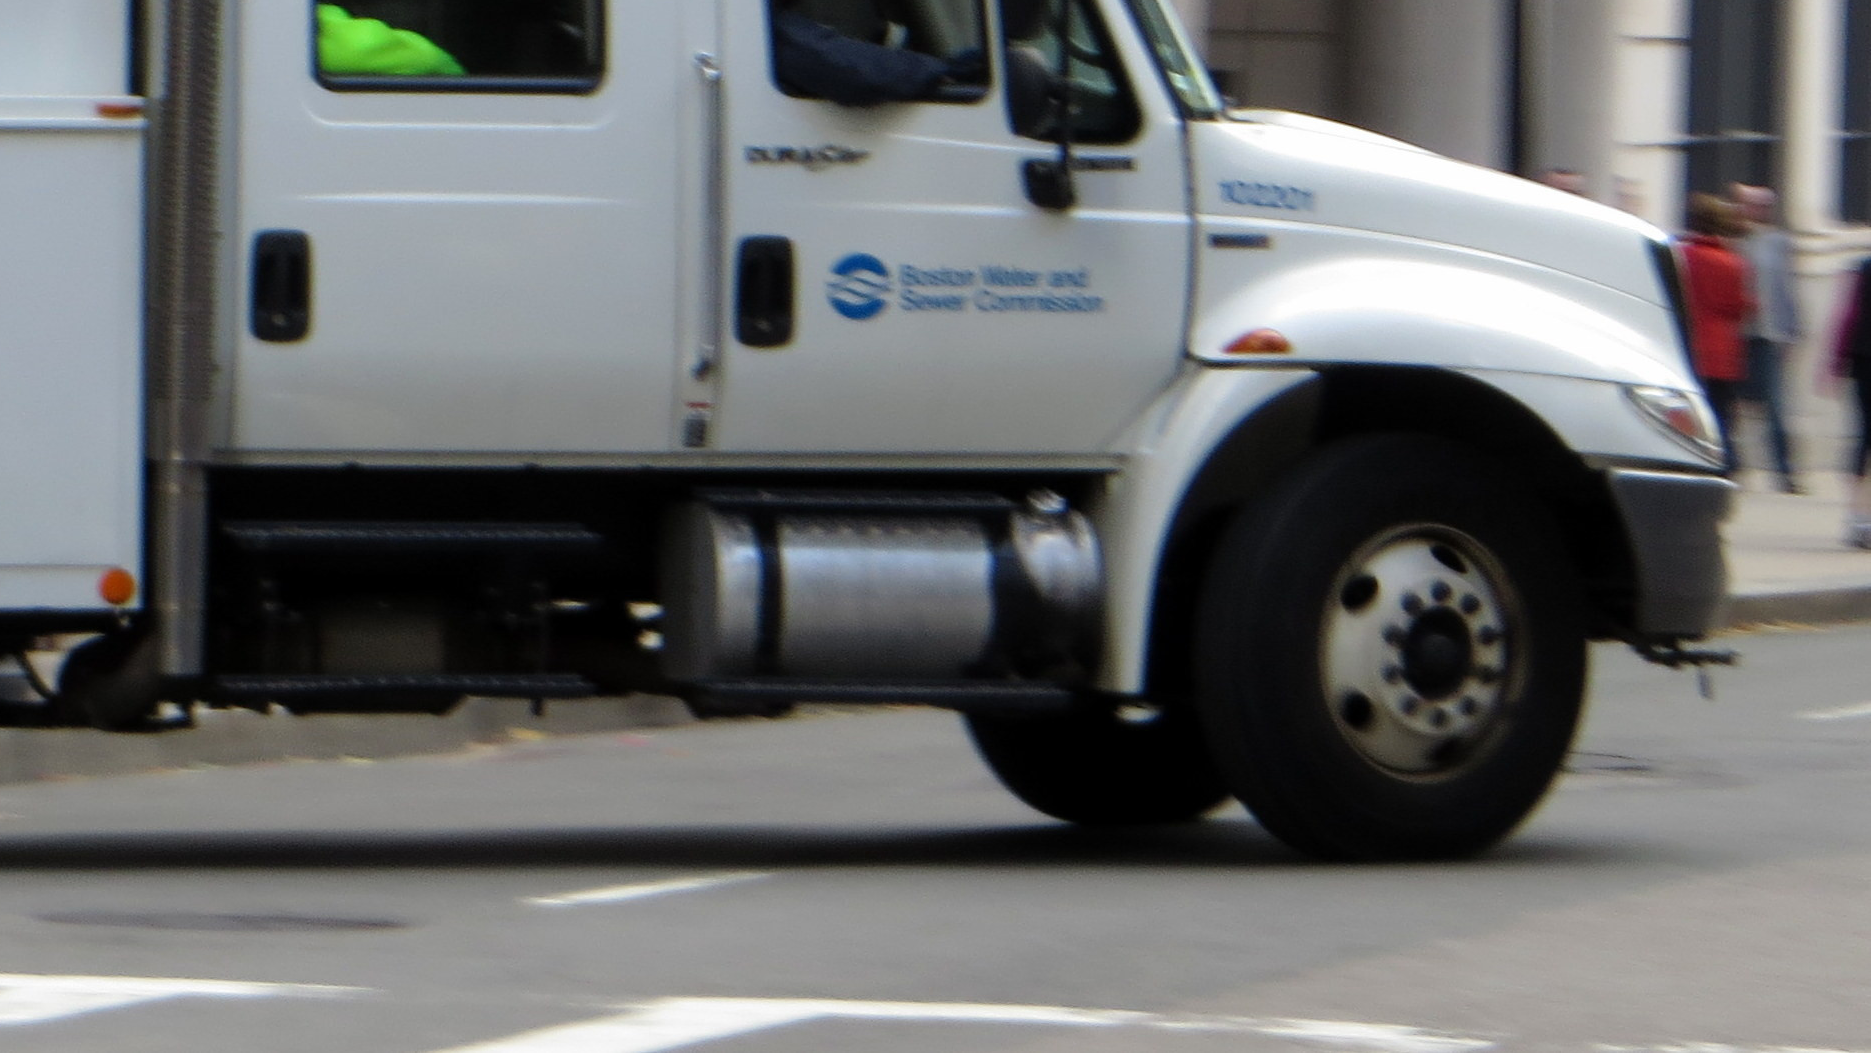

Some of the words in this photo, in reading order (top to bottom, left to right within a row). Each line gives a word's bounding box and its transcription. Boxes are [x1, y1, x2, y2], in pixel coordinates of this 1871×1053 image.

[899, 263, 974, 287] Boston
[980, 264, 1040, 287] Water
[1046, 265, 1089, 288] and
[898, 288, 963, 311] Sewer
[974, 289, 1105, 312] Commission
